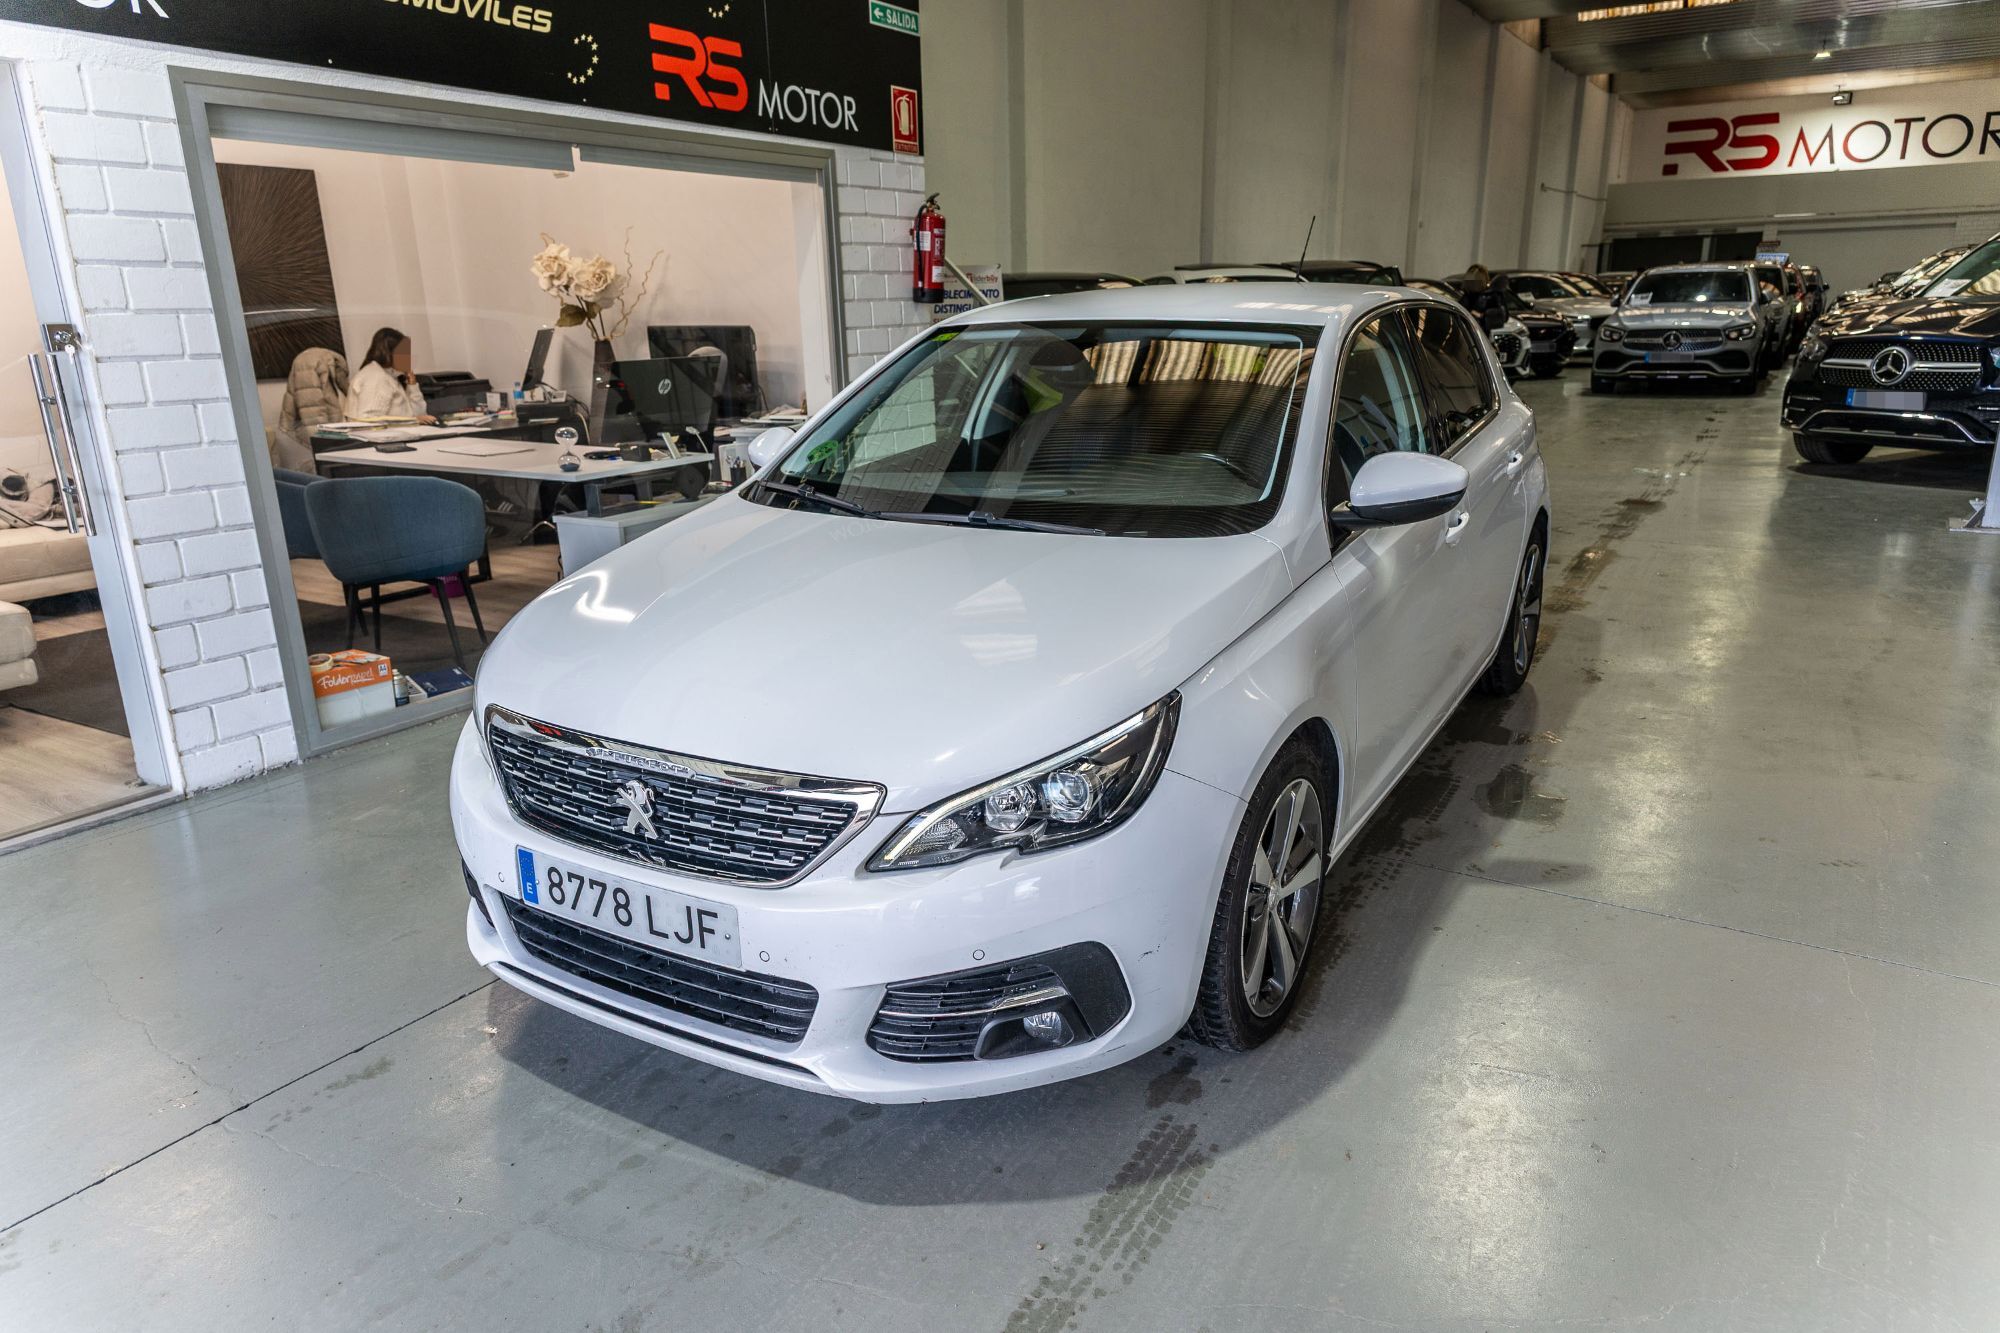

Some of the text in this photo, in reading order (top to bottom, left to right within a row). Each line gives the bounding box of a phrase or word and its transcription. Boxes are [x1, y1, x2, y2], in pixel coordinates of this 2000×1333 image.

[886, 9, 917, 31] SALIDA
[649, 23, 858, 132] RS MOTOR
[1662, 111, 2000, 176] RS MOTOR
[526, 882, 533, 895] E
[547, 867, 718, 949] 8778 LJF
